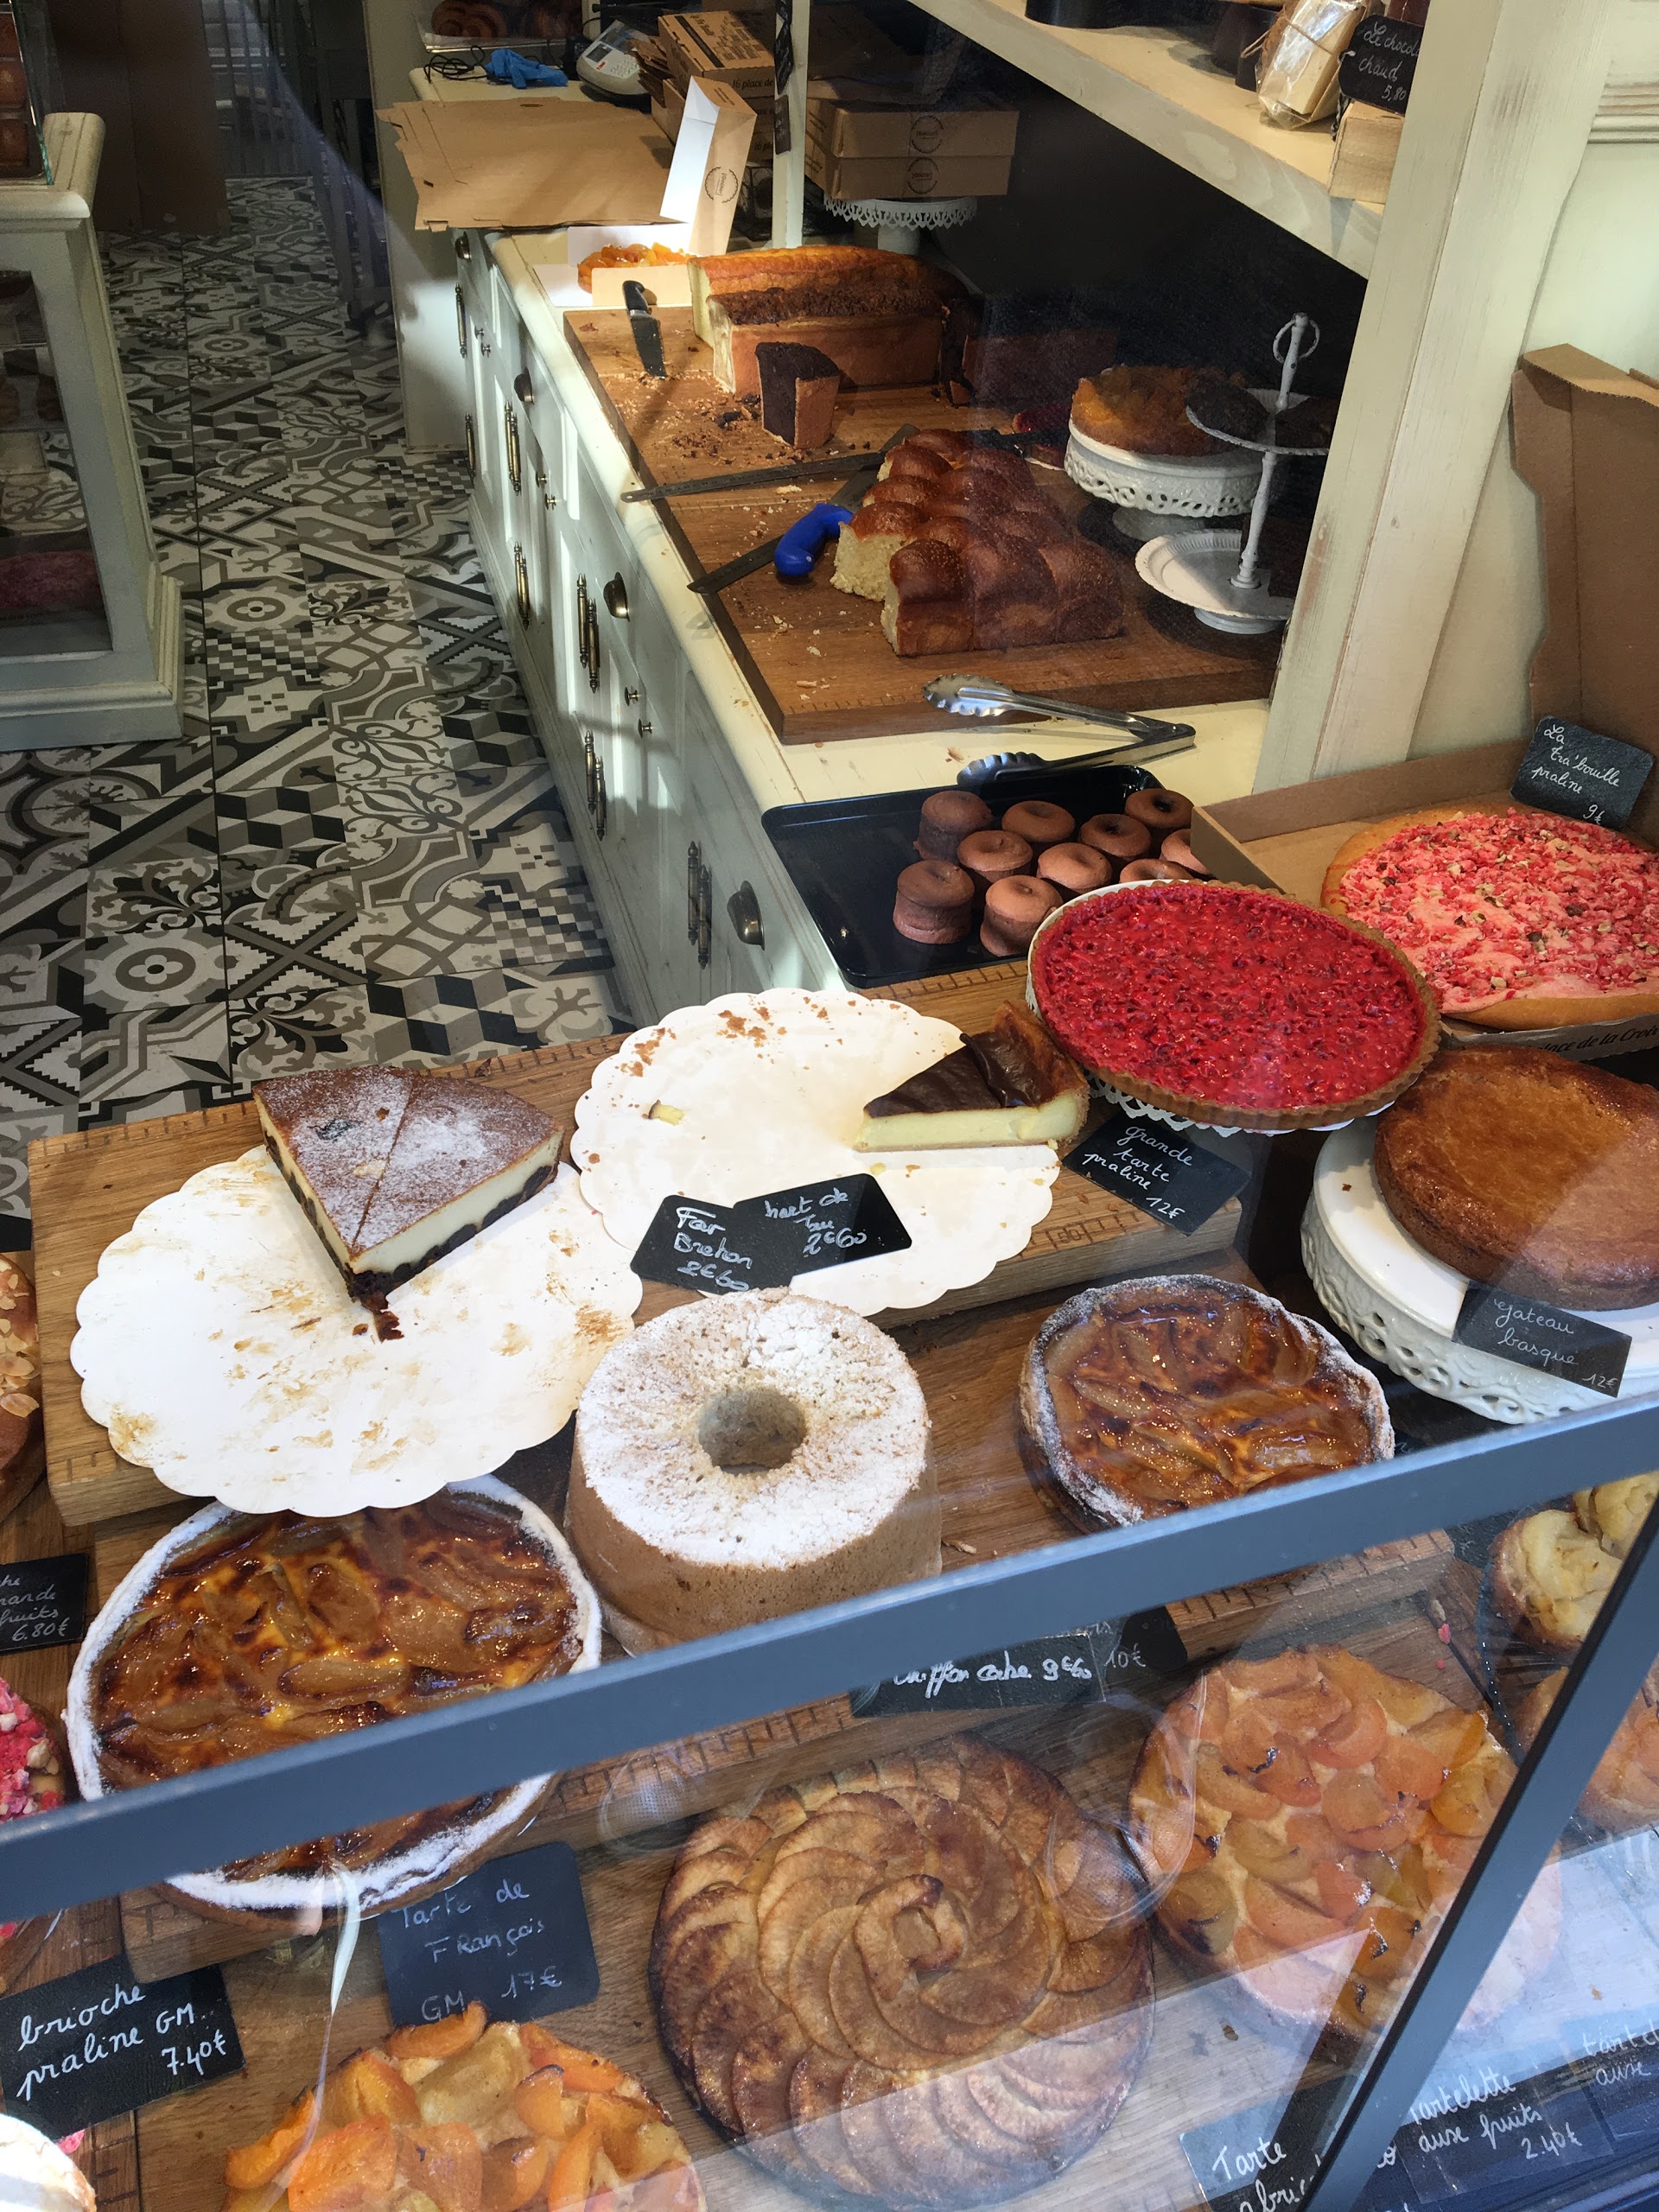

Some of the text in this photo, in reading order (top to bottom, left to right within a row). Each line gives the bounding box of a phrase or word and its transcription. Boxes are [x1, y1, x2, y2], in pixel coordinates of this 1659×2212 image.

[1358, 54, 1402, 82] chaud
[1543, 724, 1565, 745] La
[1531, 766, 1583, 794] praline
[1539, 1041, 1575, 1052] lace
[1577, 1036, 1598, 1049] de
[1599, 1033, 1619, 1046] la
[1082, 1153, 1153, 1191] praline
[1113, 1147, 1170, 1183] tarte
[676, 1207, 726, 1235] Far
[1146, 1196, 1185, 1219] 12€
[673, 1232, 753, 1269] Breton
[1497, 1328, 1579, 1367] basque
[1582, 1373, 1618, 1389] 12€
[391, 1879, 530, 1929] Tarte de
[501, 1965, 563, 1999] 17€
[18, 1983, 146, 2052] brioche
[421, 1990, 465, 2021] GM
[16, 2027, 143, 2101] praline
[162, 2030, 226, 2075] 7.40€
[1479, 2102, 1542, 2150] fruits
[1521, 2122, 1583, 2160] 2.40€
[1212, 2137, 1287, 2181] Tarte
